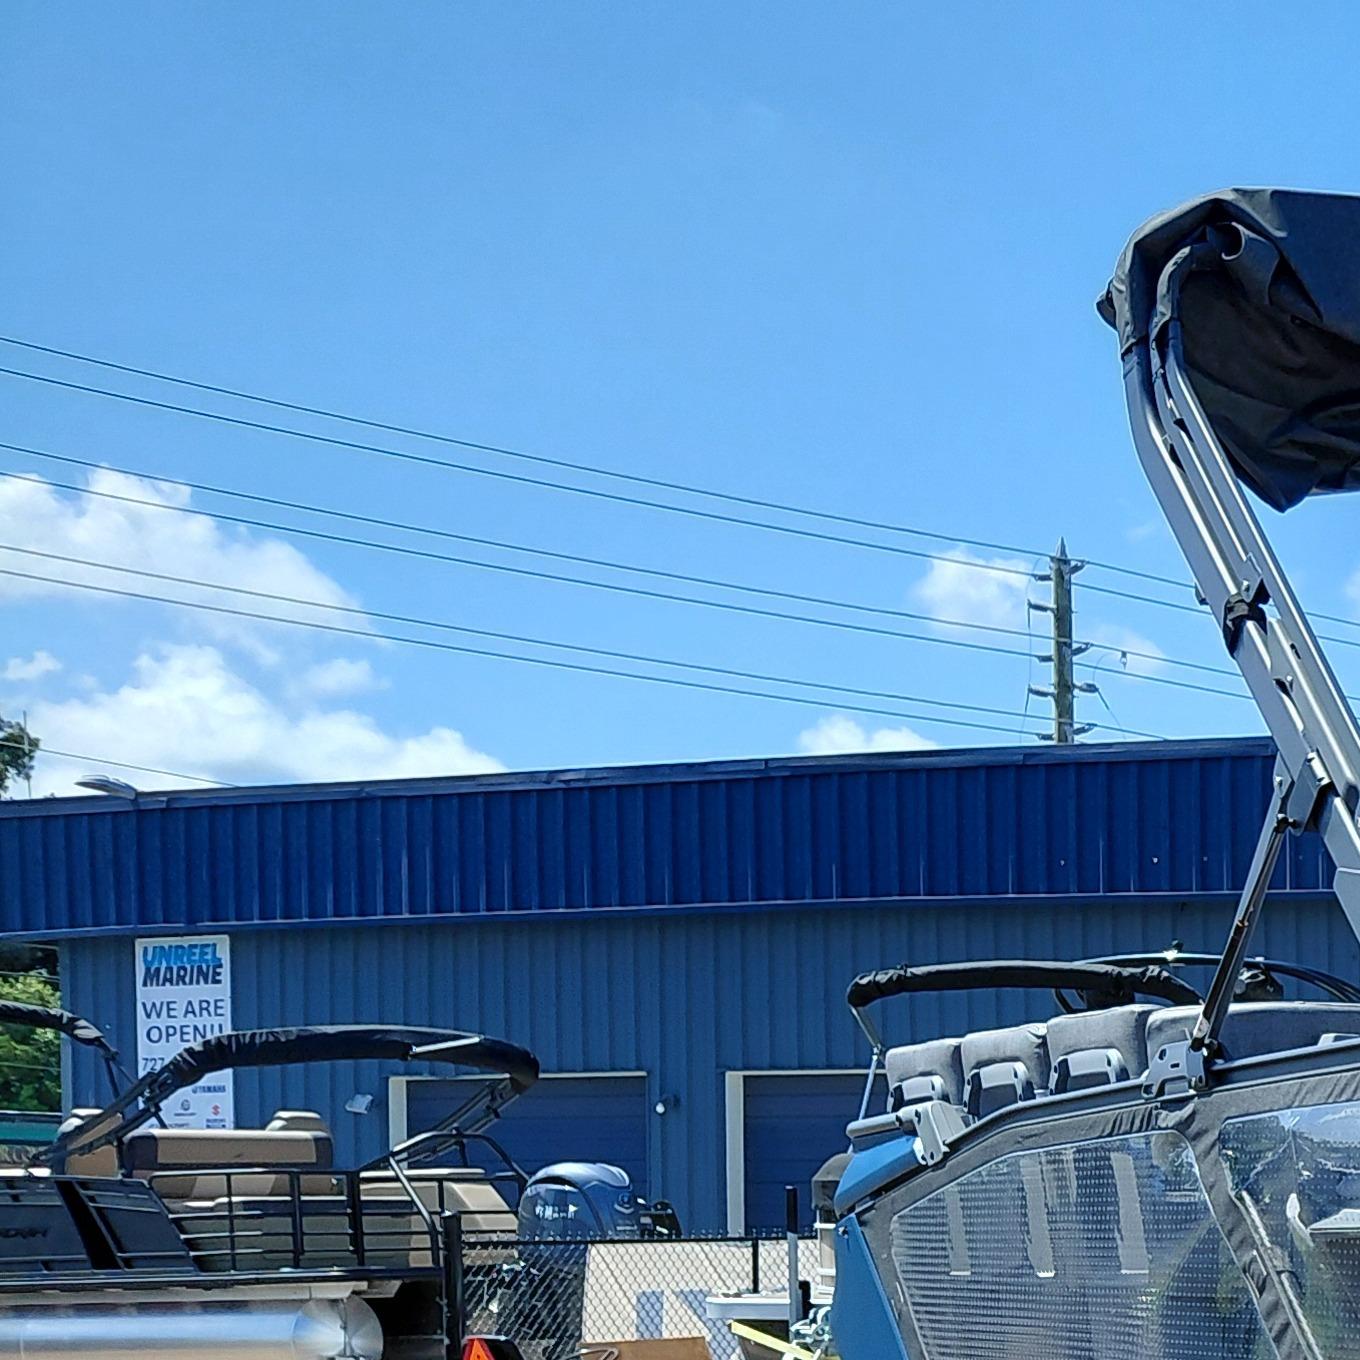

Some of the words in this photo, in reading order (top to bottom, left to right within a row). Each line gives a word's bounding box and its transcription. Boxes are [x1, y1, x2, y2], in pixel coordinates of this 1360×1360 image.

[142, 943, 222, 966] UNREEL
[142, 964, 223, 987] MARINE
[142, 1000, 178, 1019] WE
[183, 998, 225, 1018] ARE
